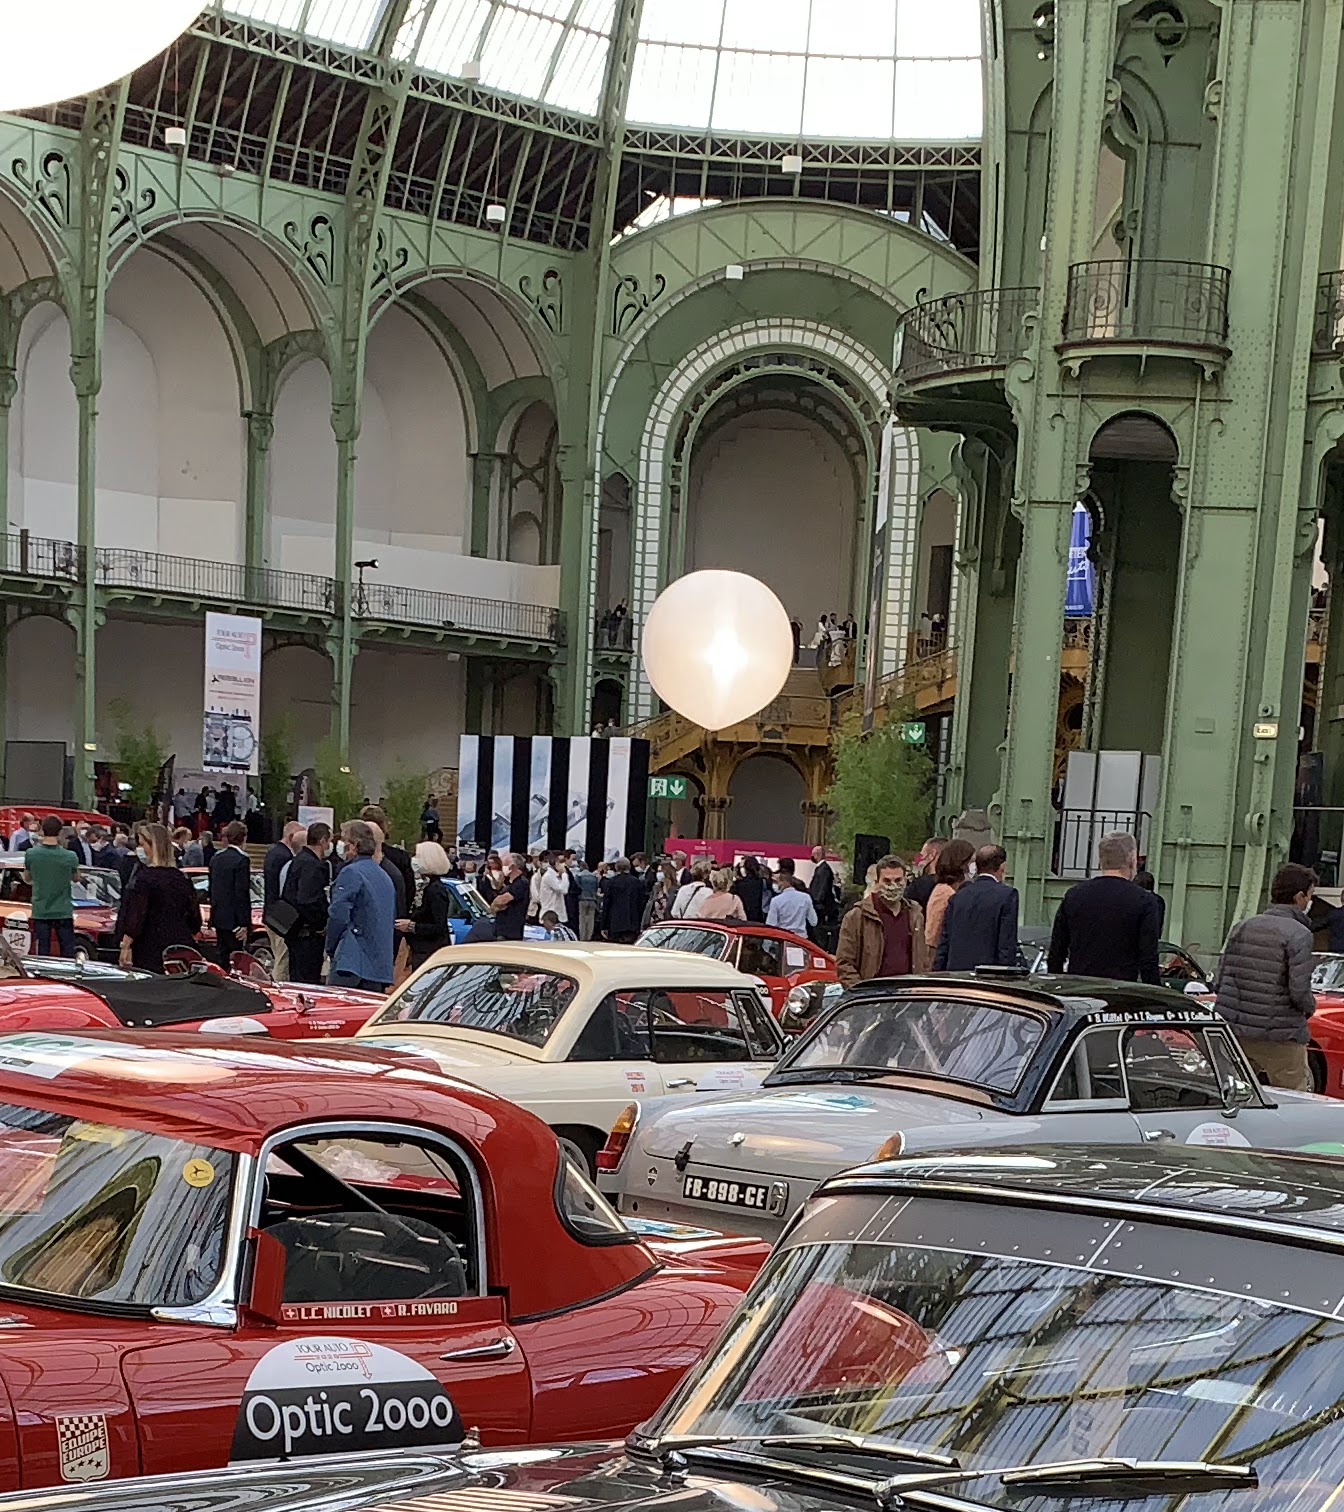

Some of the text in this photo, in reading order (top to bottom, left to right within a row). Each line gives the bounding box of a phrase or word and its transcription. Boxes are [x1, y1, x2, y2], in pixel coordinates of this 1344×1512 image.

[398, 1302, 458, 1317] R.FAVARO
[295, 1342, 349, 1353] TOUR AUTO
[305, 1360, 359, 1374] Optic 2000
[246, 1388, 454, 1453] Optic 2000
[61, 1426, 105, 1453] EQUIPE
[62, 1437, 106, 1464] EUROPE
